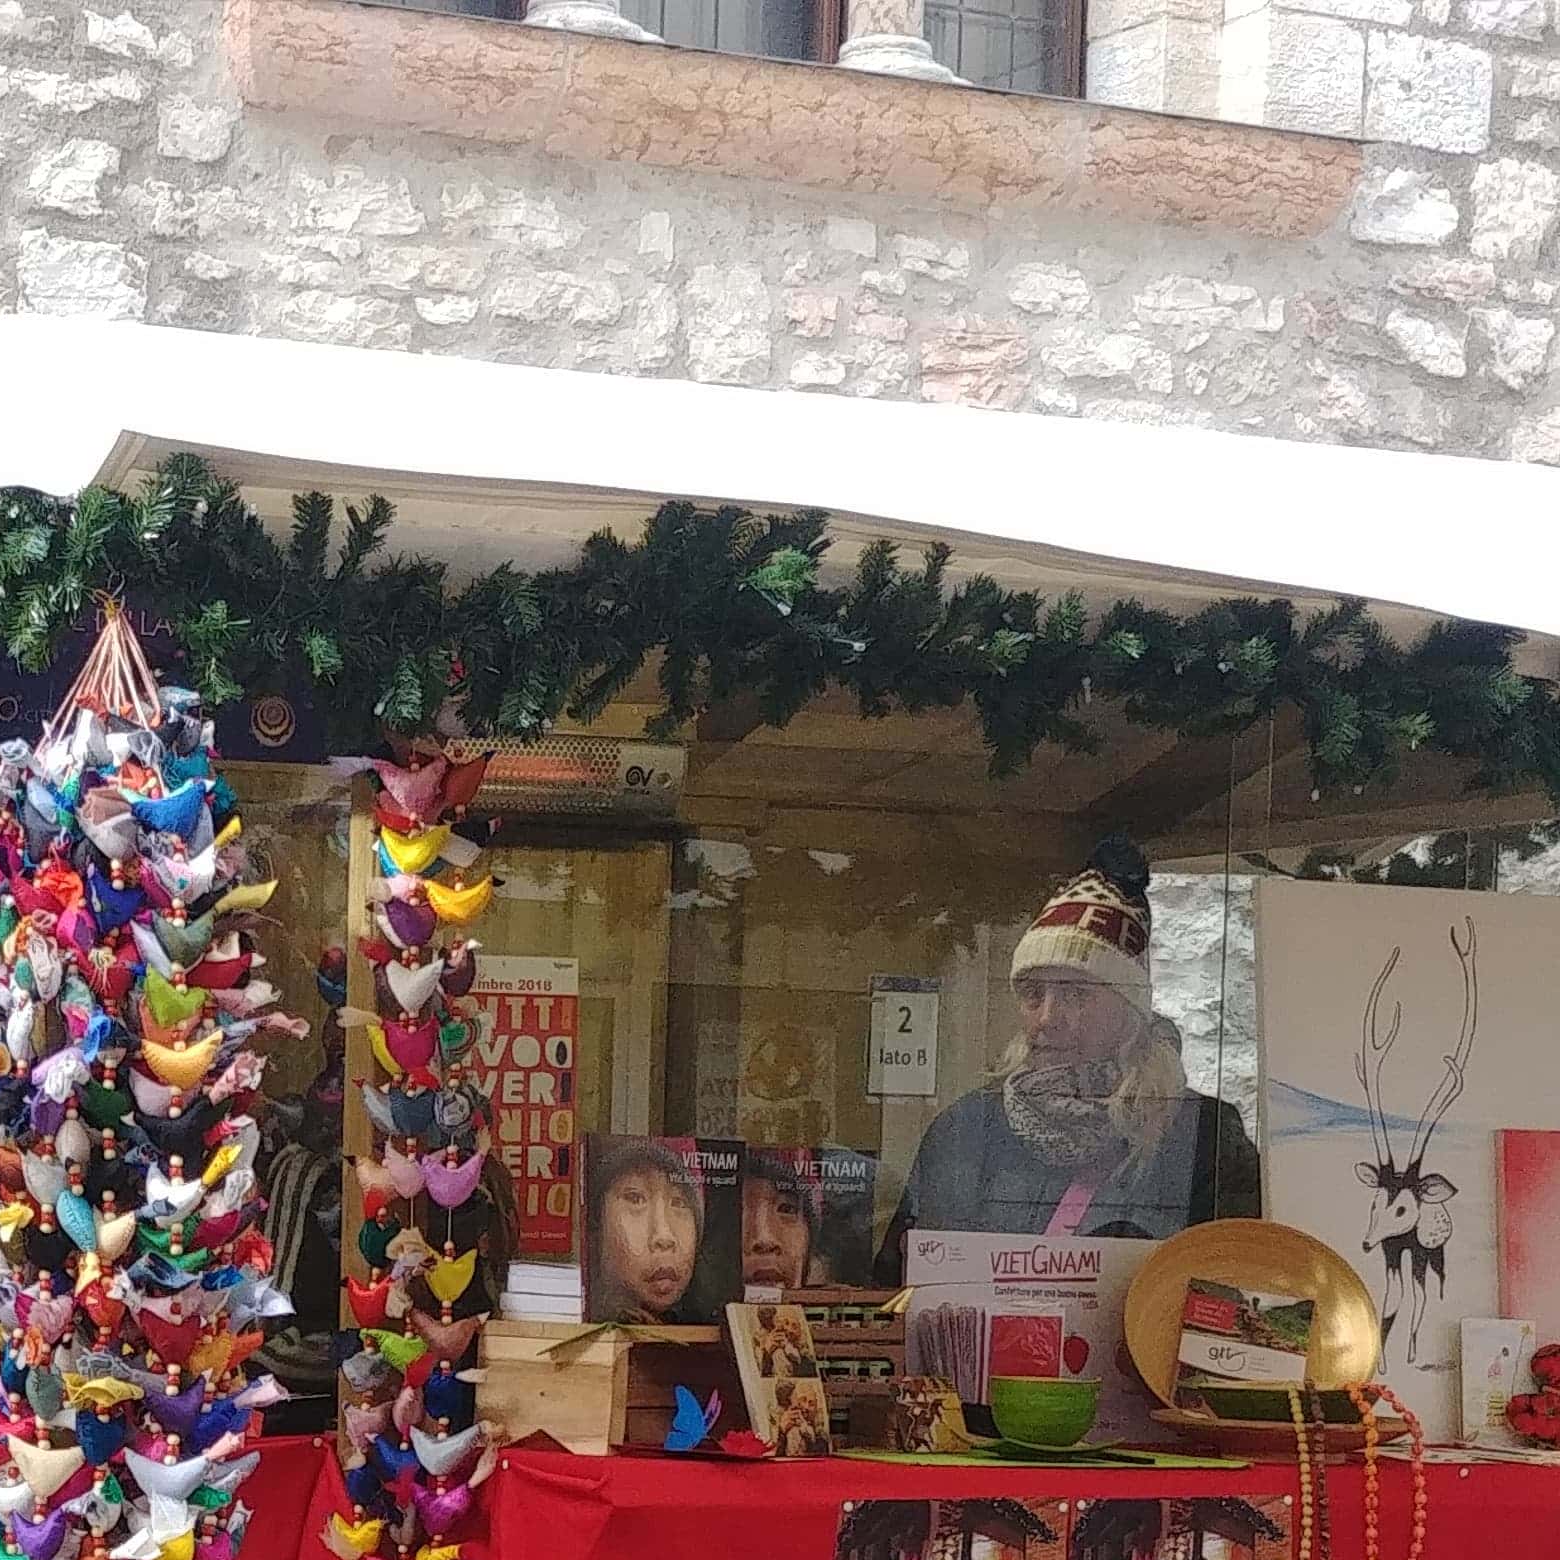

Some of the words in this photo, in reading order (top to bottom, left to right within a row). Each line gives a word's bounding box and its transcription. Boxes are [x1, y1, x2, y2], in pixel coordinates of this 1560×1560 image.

[477, 978, 513, 991] mbre
[898, 1005, 913, 1033] 2
[917, 1049, 928, 1066] B
[682, 1151, 738, 1170] VIETNAM
[793, 1160, 866, 1178] VIETNAM
